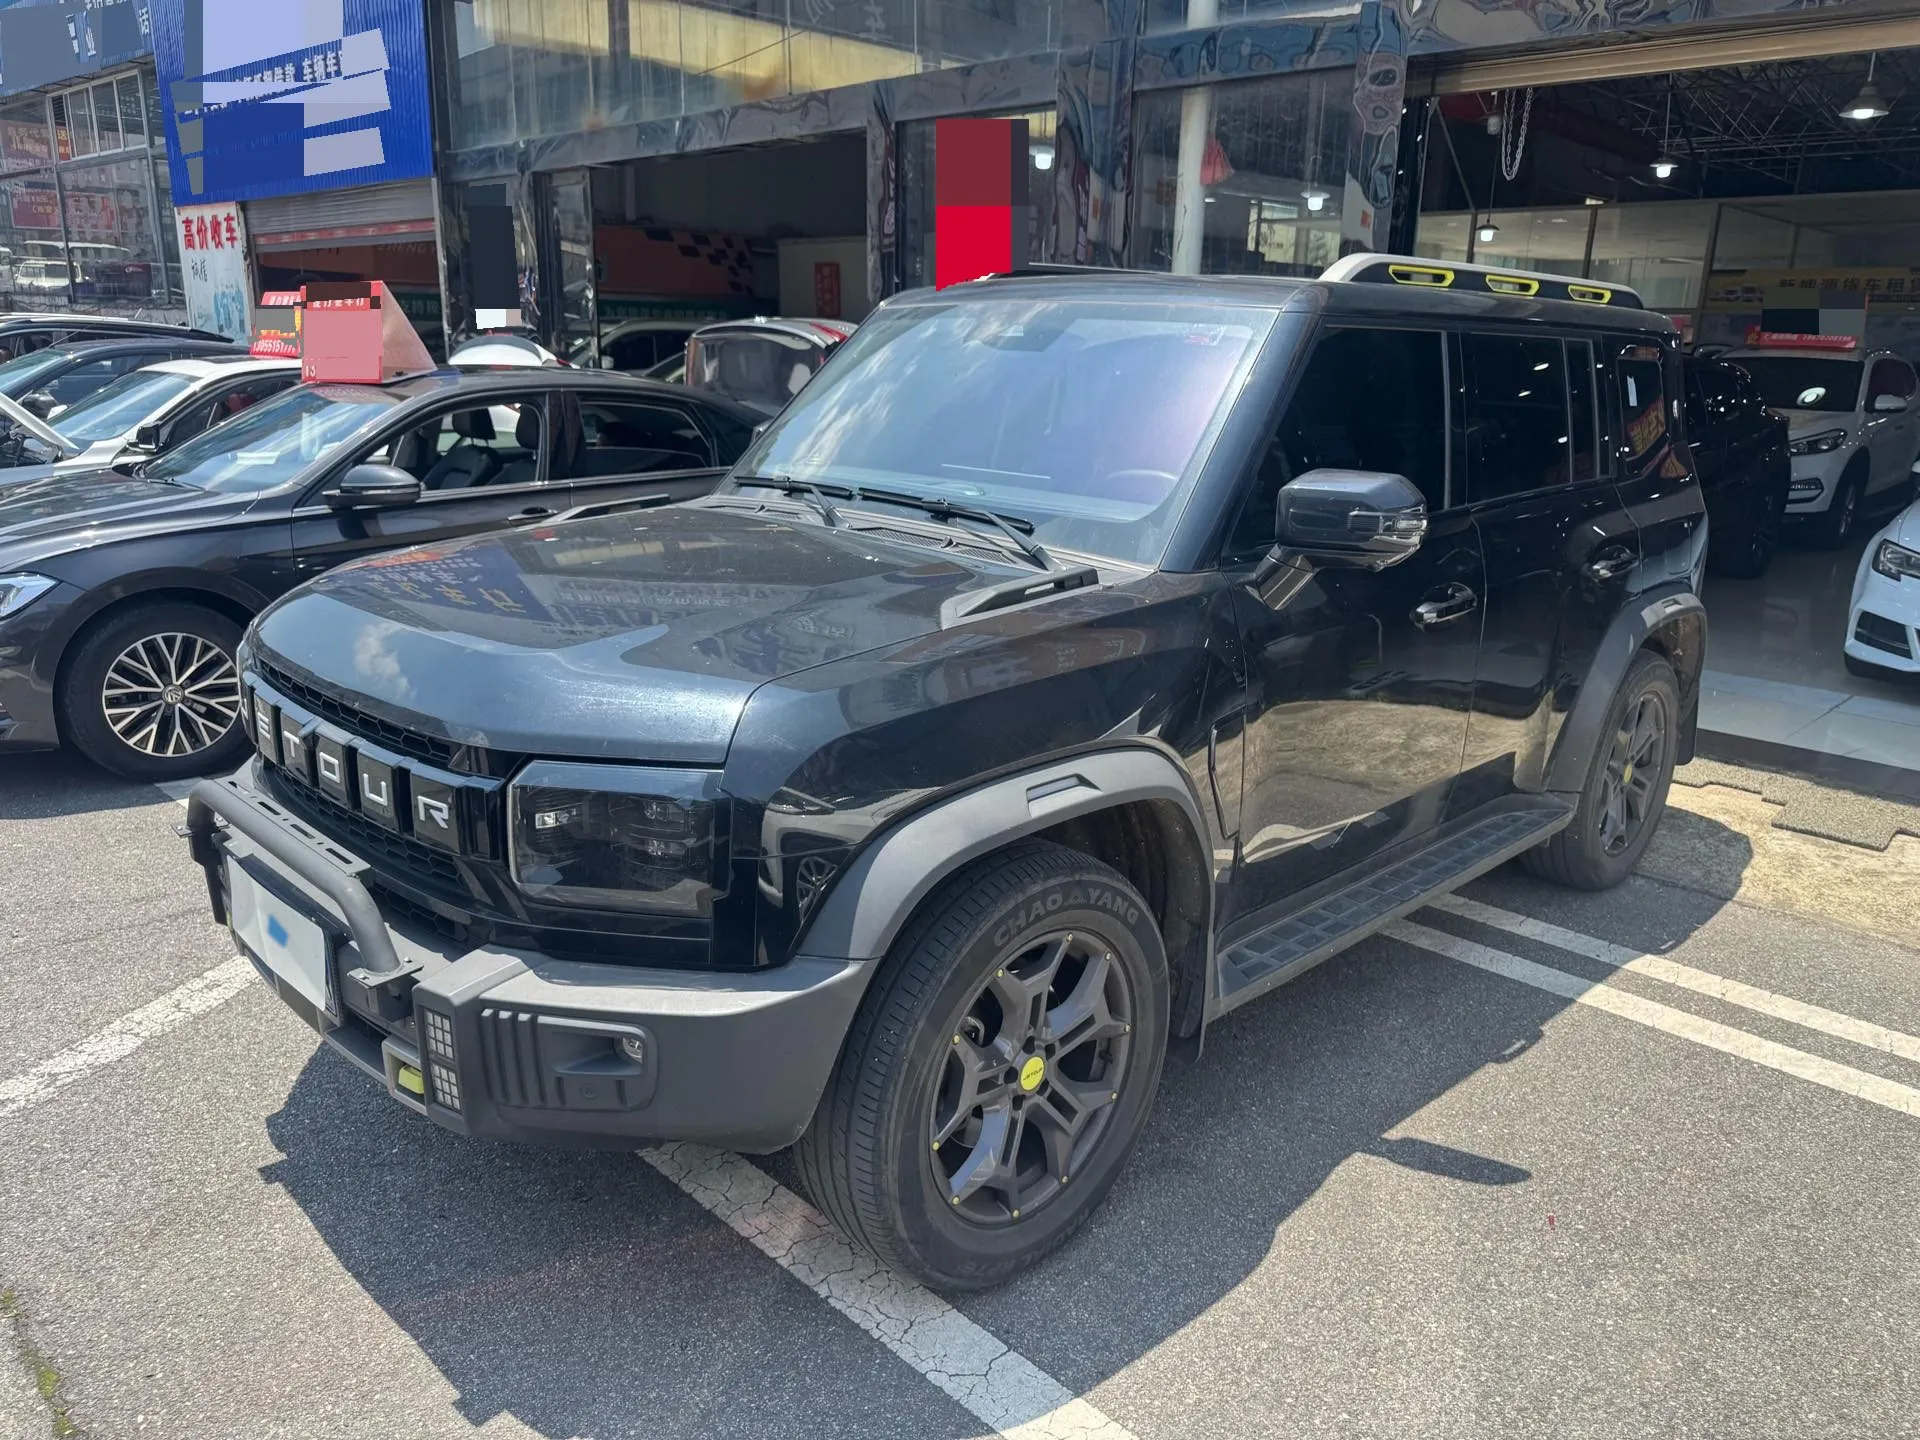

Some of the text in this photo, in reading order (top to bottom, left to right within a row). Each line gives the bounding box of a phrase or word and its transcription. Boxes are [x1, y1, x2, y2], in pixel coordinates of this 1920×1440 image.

[302, 50, 342, 82] 车辆年
[182, 212, 238, 250] 高价收车
[994, 887, 1140, 947] CHAO YANG
